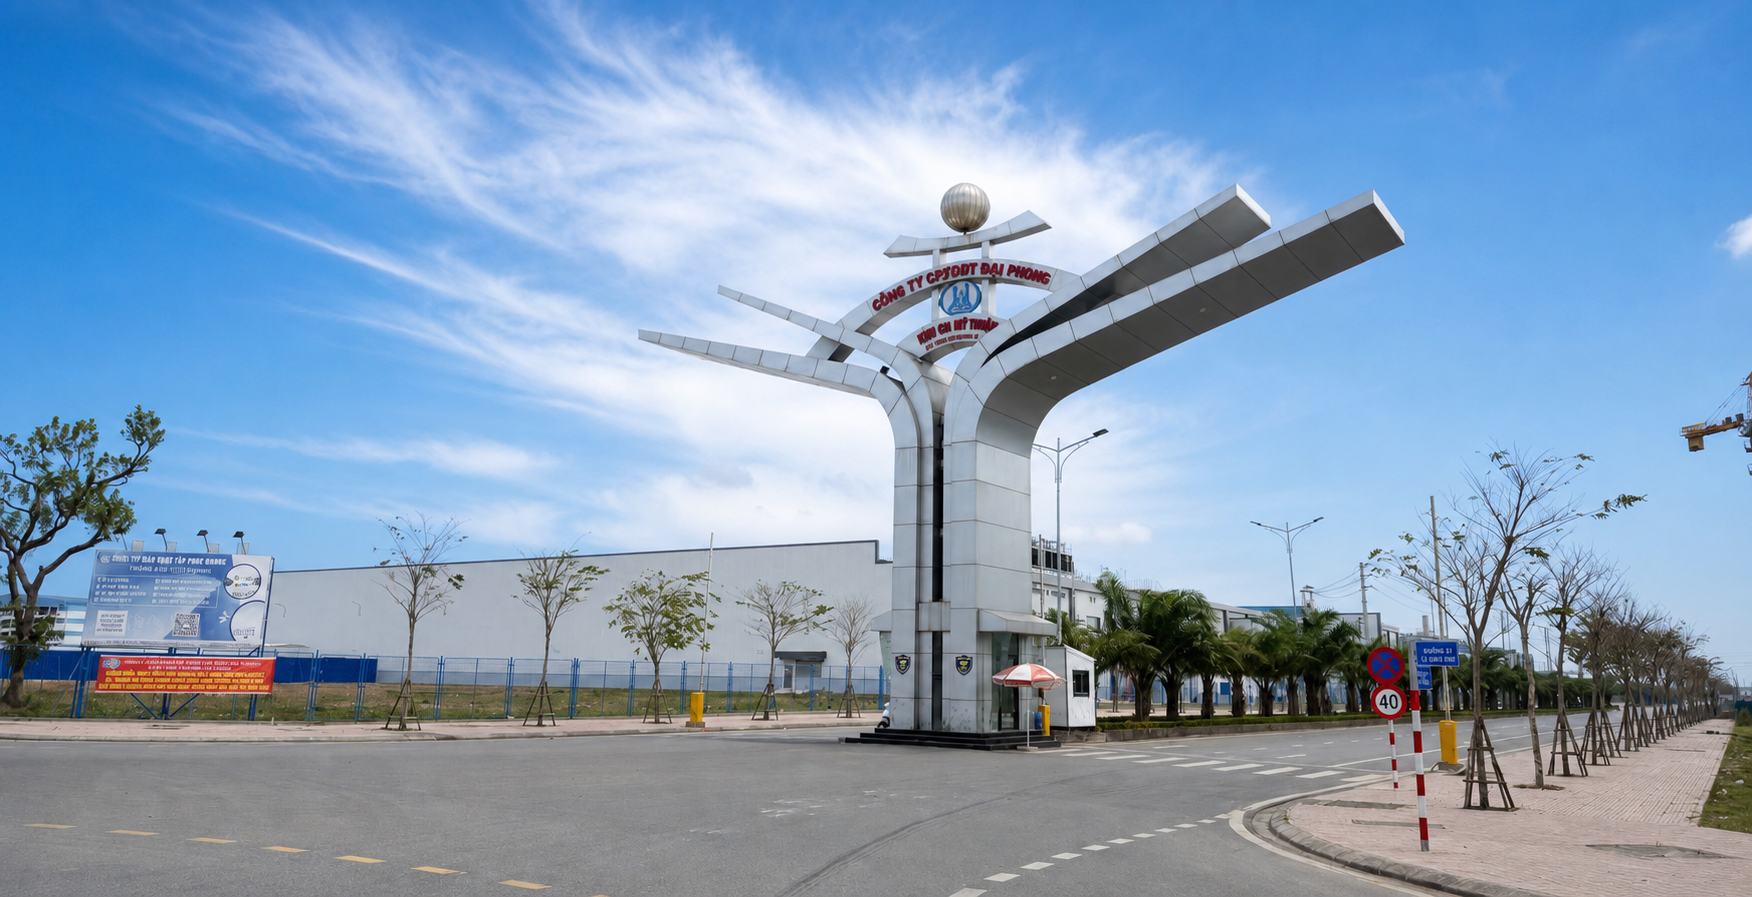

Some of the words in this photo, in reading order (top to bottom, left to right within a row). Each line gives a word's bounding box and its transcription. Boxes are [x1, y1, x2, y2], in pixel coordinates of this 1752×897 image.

[906, 275, 923, 292] TY
[980, 262, 1004, 278] ĐẠI
[1006, 264, 1052, 285] PHONG
[1379, 694, 1398, 709] 40
